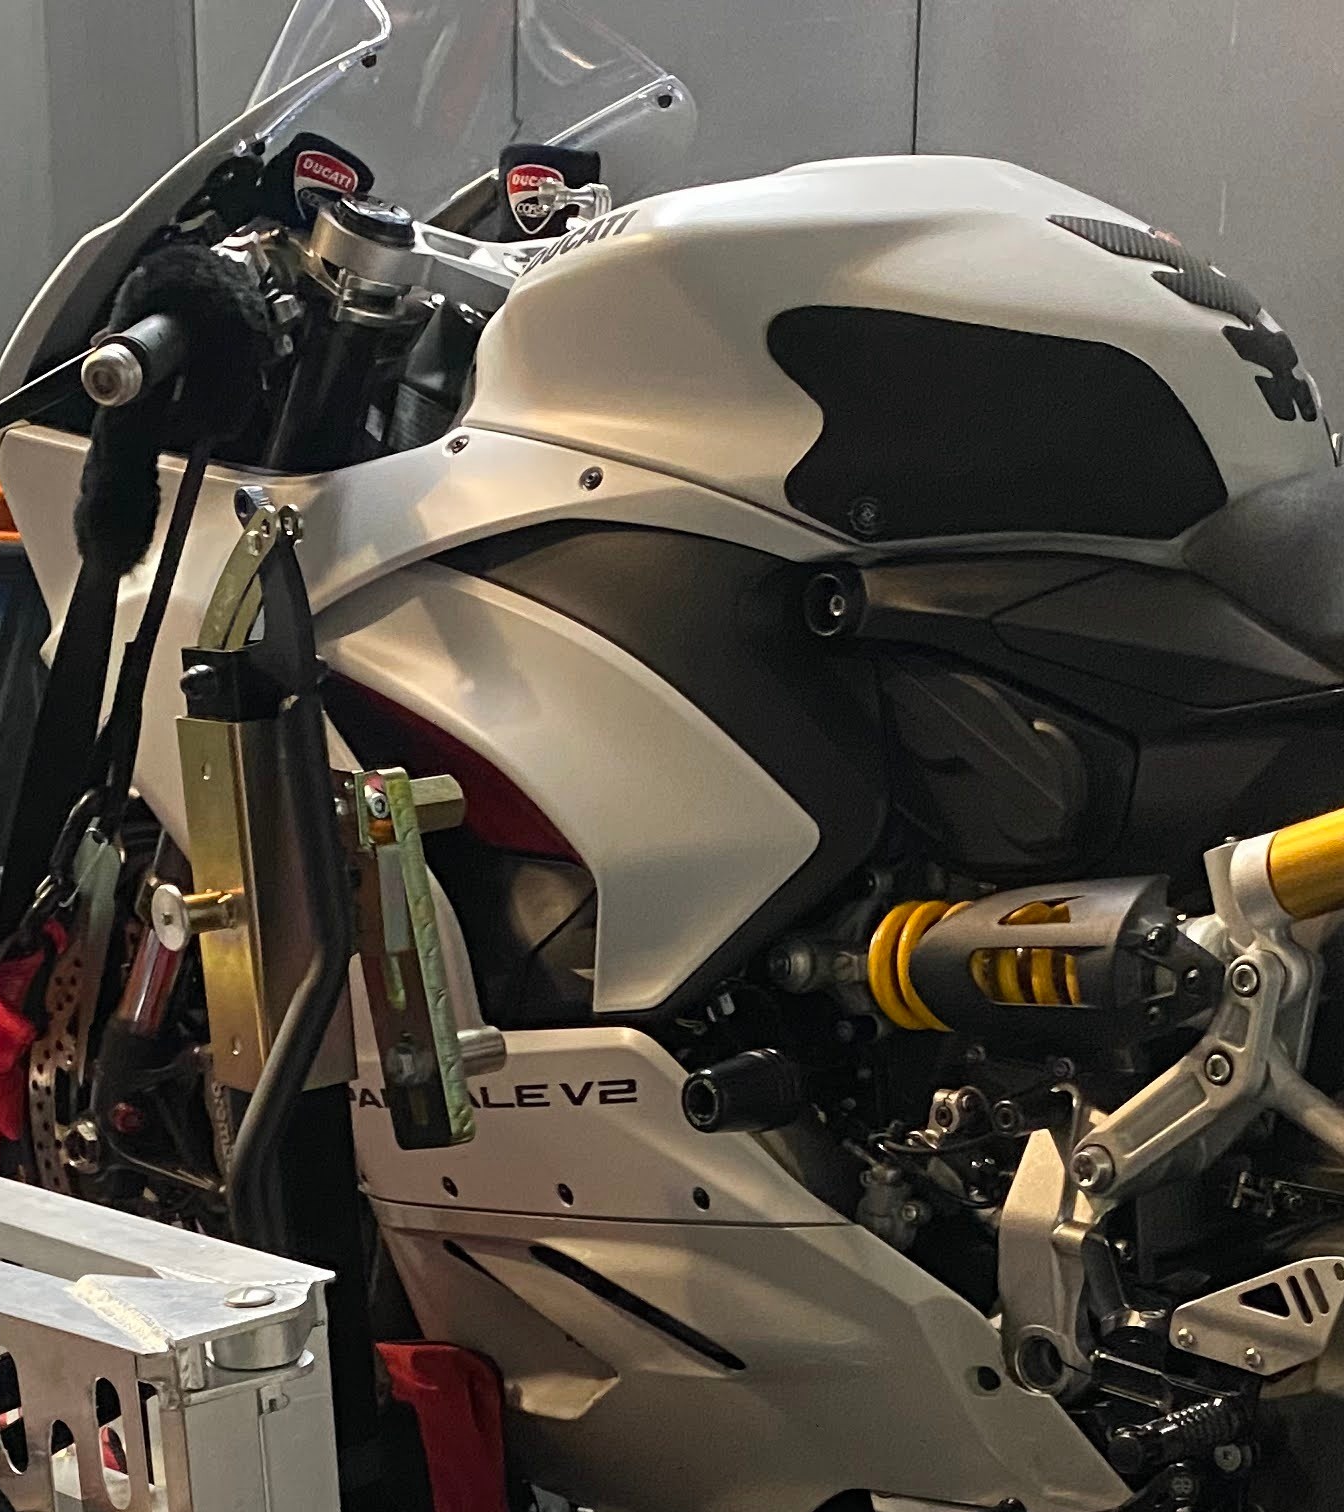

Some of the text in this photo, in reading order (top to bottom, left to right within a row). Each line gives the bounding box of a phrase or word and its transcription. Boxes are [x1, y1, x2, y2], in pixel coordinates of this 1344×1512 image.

[302, 158, 352, 189] DUCATI
[520, 209, 640, 278] DUCATI
[558, 1078, 638, 1106] V2
